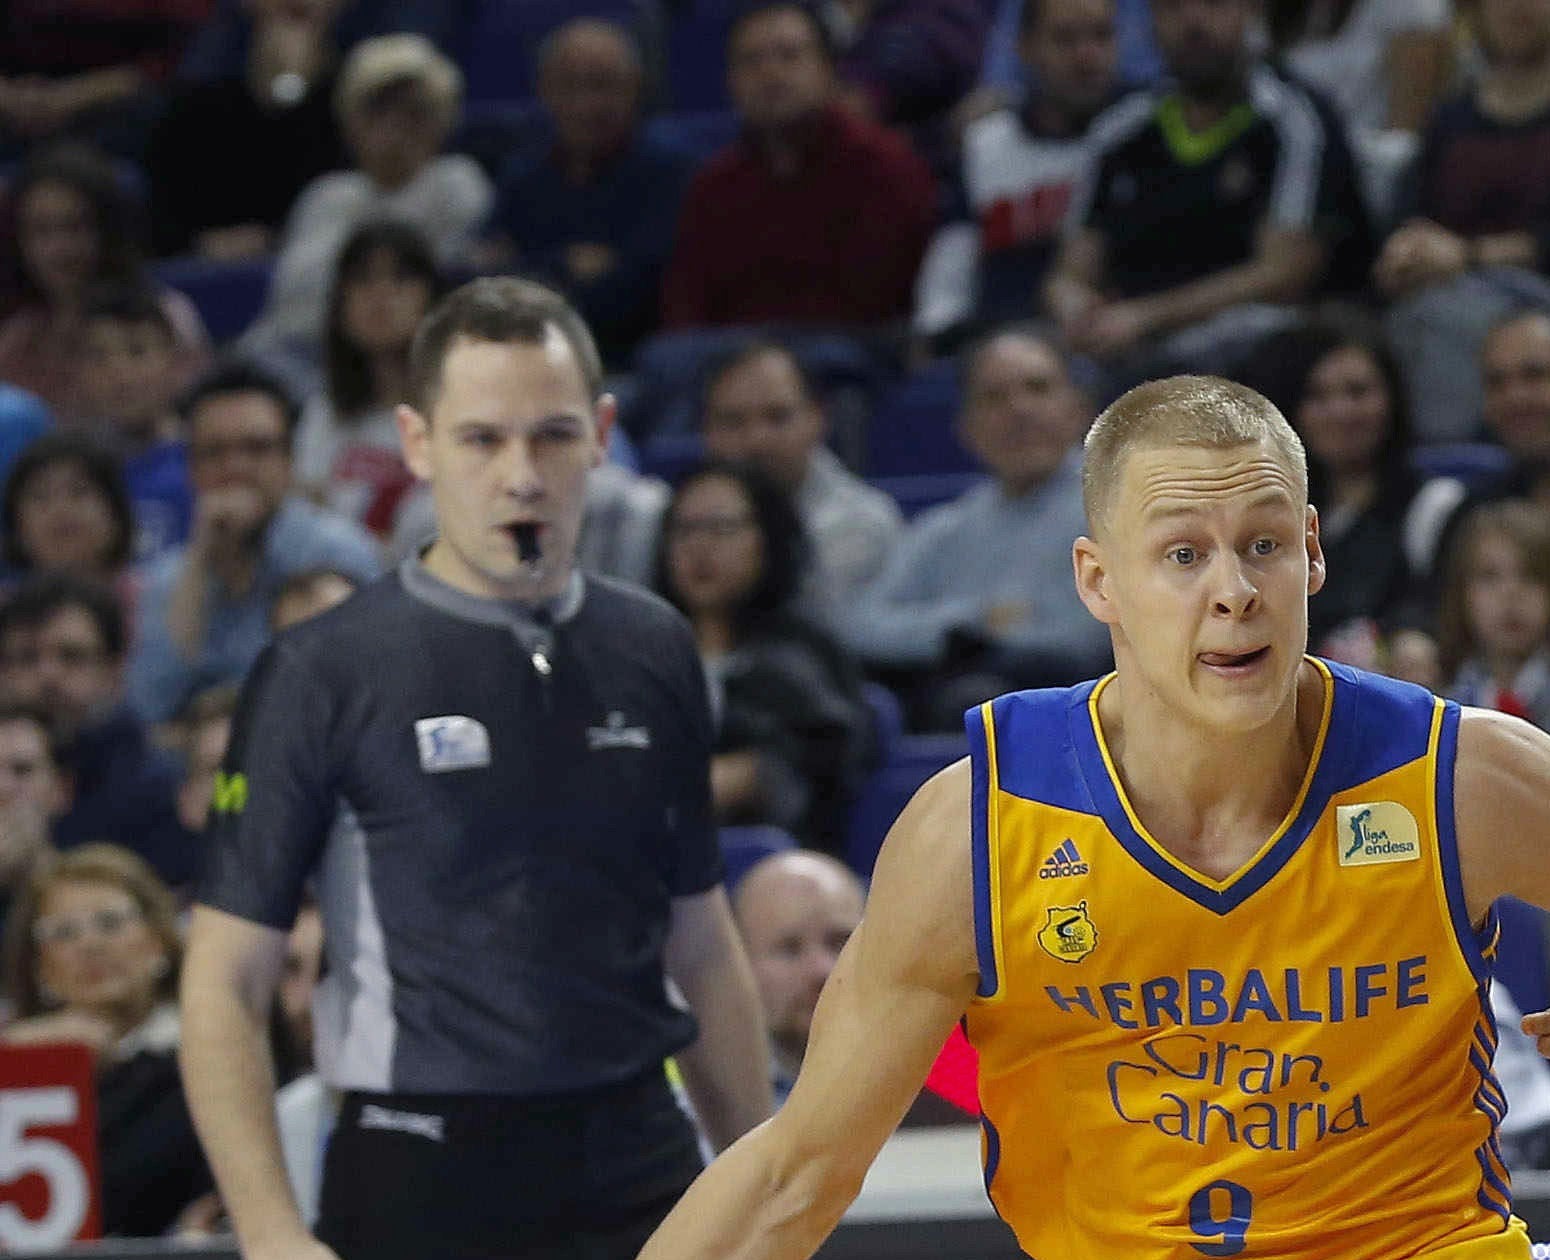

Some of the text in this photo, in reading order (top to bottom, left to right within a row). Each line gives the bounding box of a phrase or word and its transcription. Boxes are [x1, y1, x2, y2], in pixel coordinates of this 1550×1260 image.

[1363, 823, 1388, 844] liga
[1365, 841, 1414, 855] endesa
[1039, 862, 1088, 879] adidas
[1044, 955, 1429, 1030] HERBALIFE
[1143, 1033, 1324, 1095] Gran
[1107, 1060, 1370, 1152] Canaria
[0, 1085, 89, 1254] 5
[1188, 1179, 1254, 1257] 9
